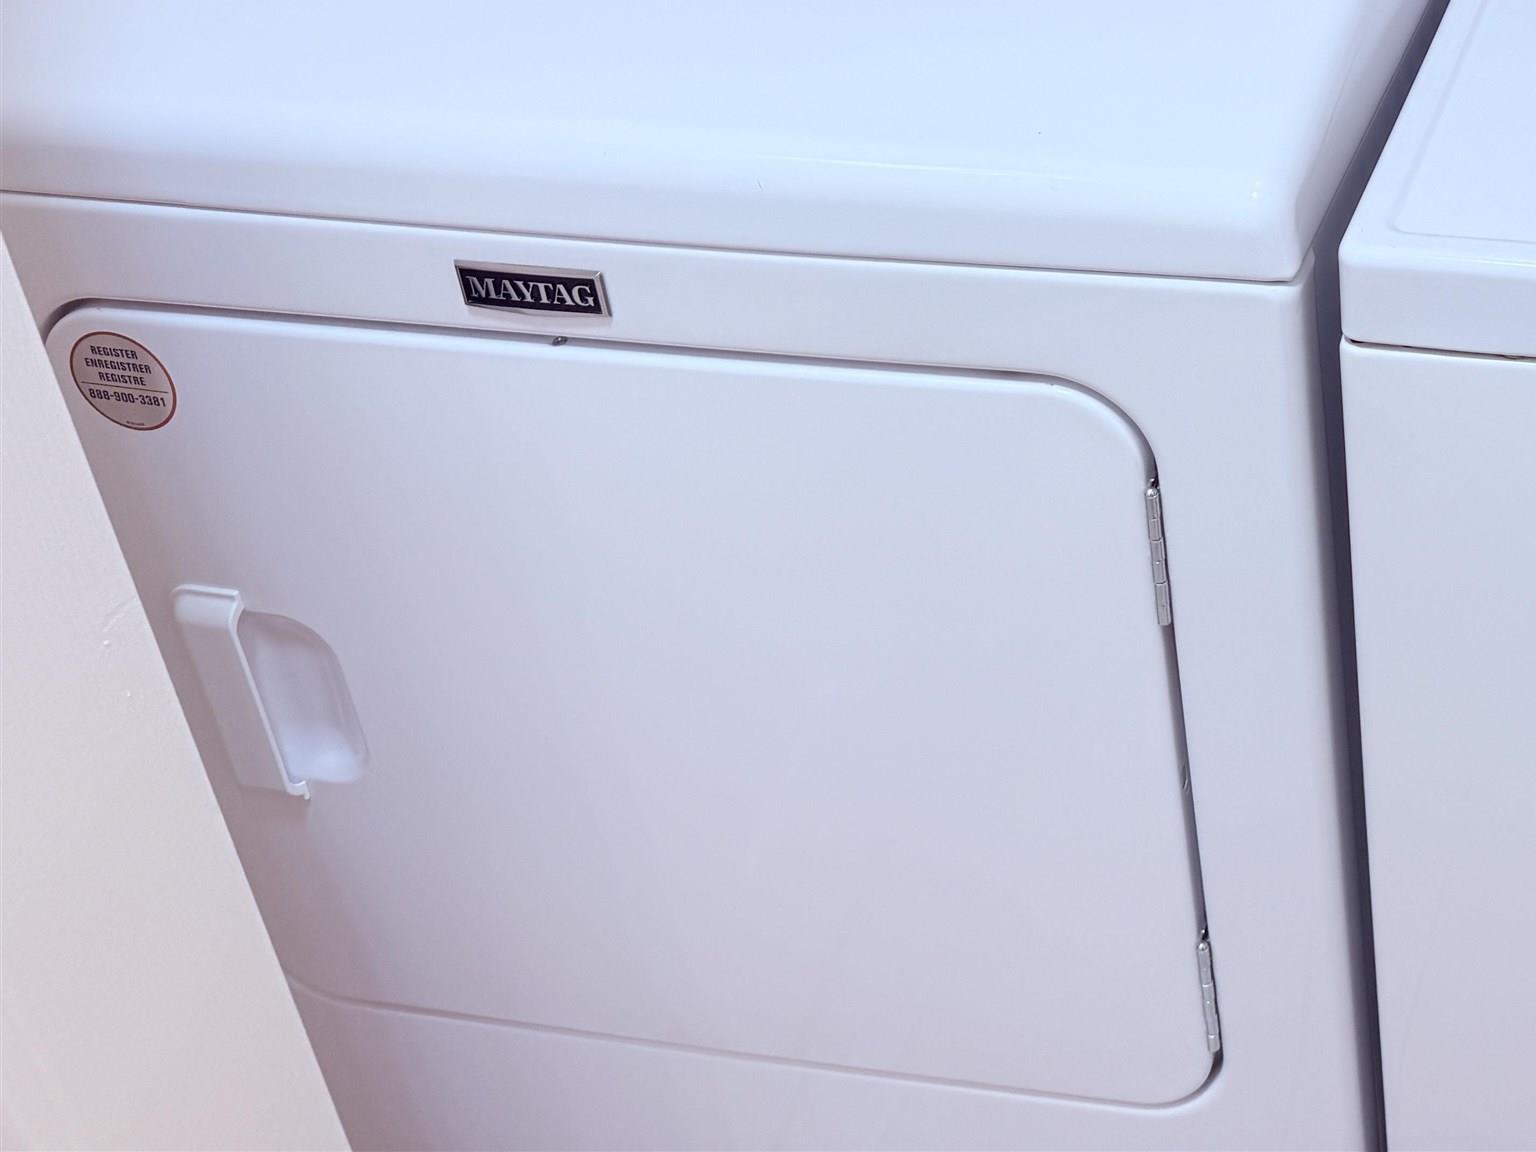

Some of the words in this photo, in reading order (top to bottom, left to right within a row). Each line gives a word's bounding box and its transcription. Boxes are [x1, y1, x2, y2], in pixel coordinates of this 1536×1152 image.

[465, 276, 595, 307] MAYTAG
[90, 345, 138, 360] REGISTER
[84, 357, 152, 375] ENREGISTRER
[98, 371, 147, 387] REGISTRE
[88, 388, 167, 408] 888-900-3381
